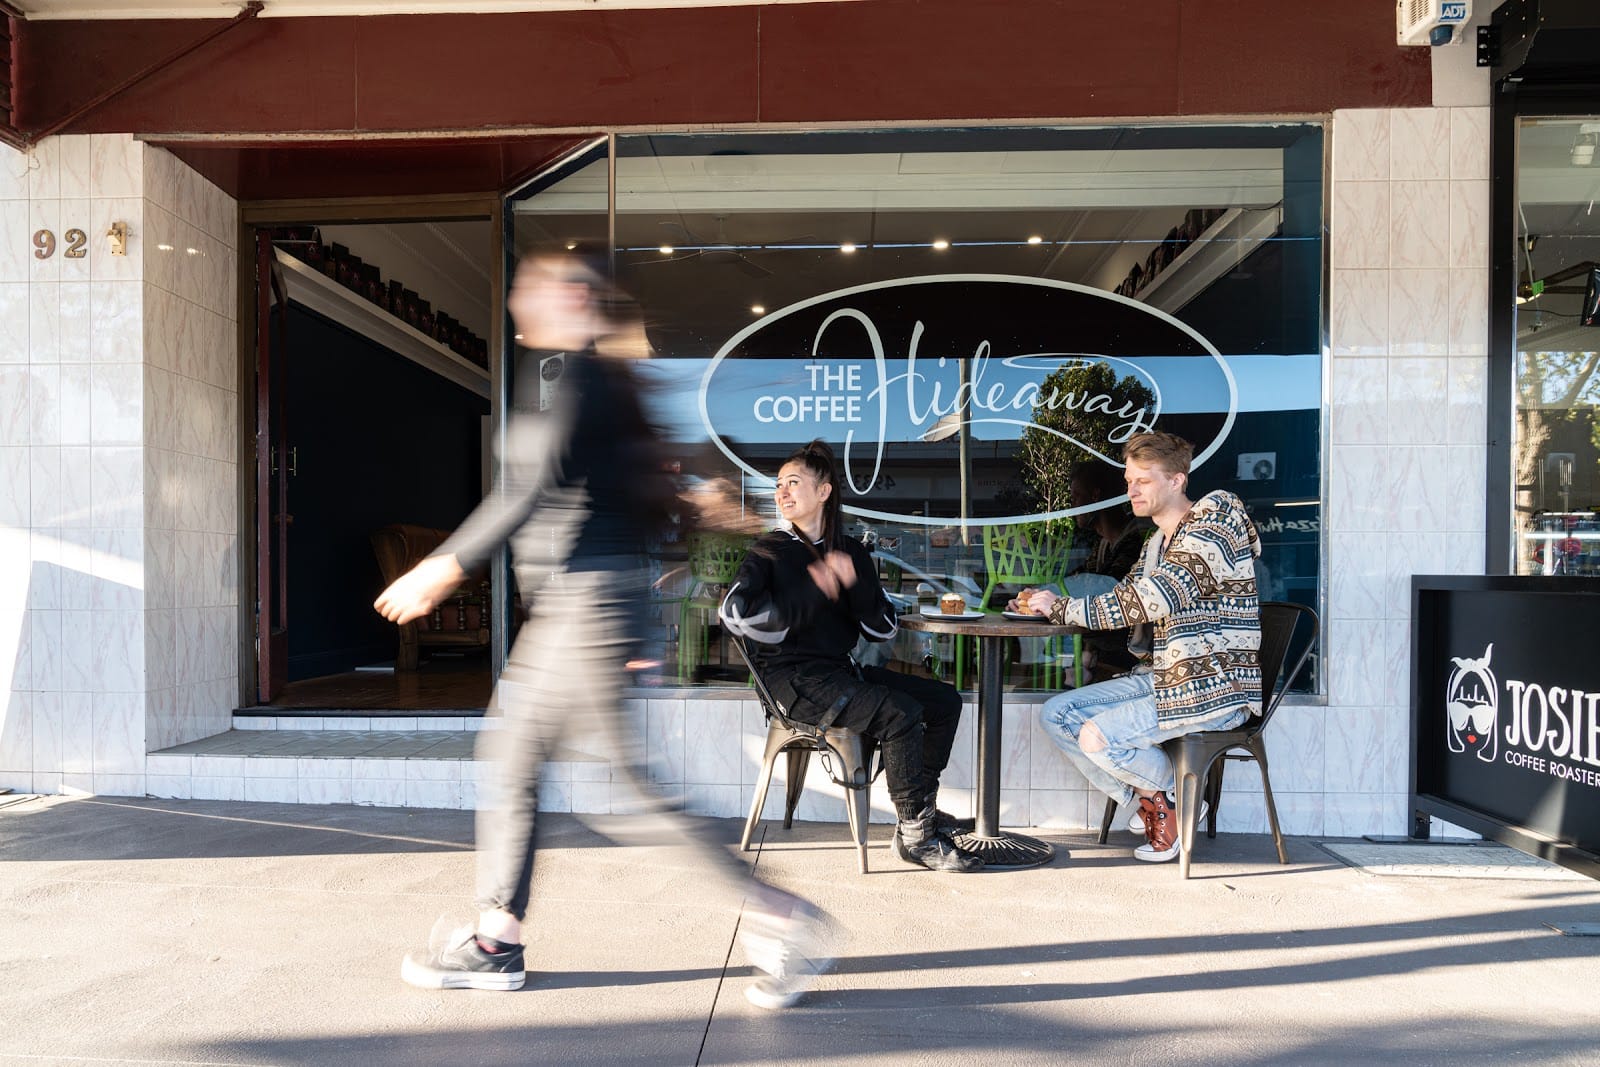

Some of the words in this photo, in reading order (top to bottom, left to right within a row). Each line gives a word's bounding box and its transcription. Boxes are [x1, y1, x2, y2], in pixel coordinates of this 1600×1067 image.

[1441, 5, 1467, 18] ADT
[33, 229, 87, 259] 92
[804, 365, 862, 391] THE
[753, 396, 862, 423] COFFEE
[812, 308, 1163, 495] Hideaway
[1505, 751, 1546, 773] COFFEE
